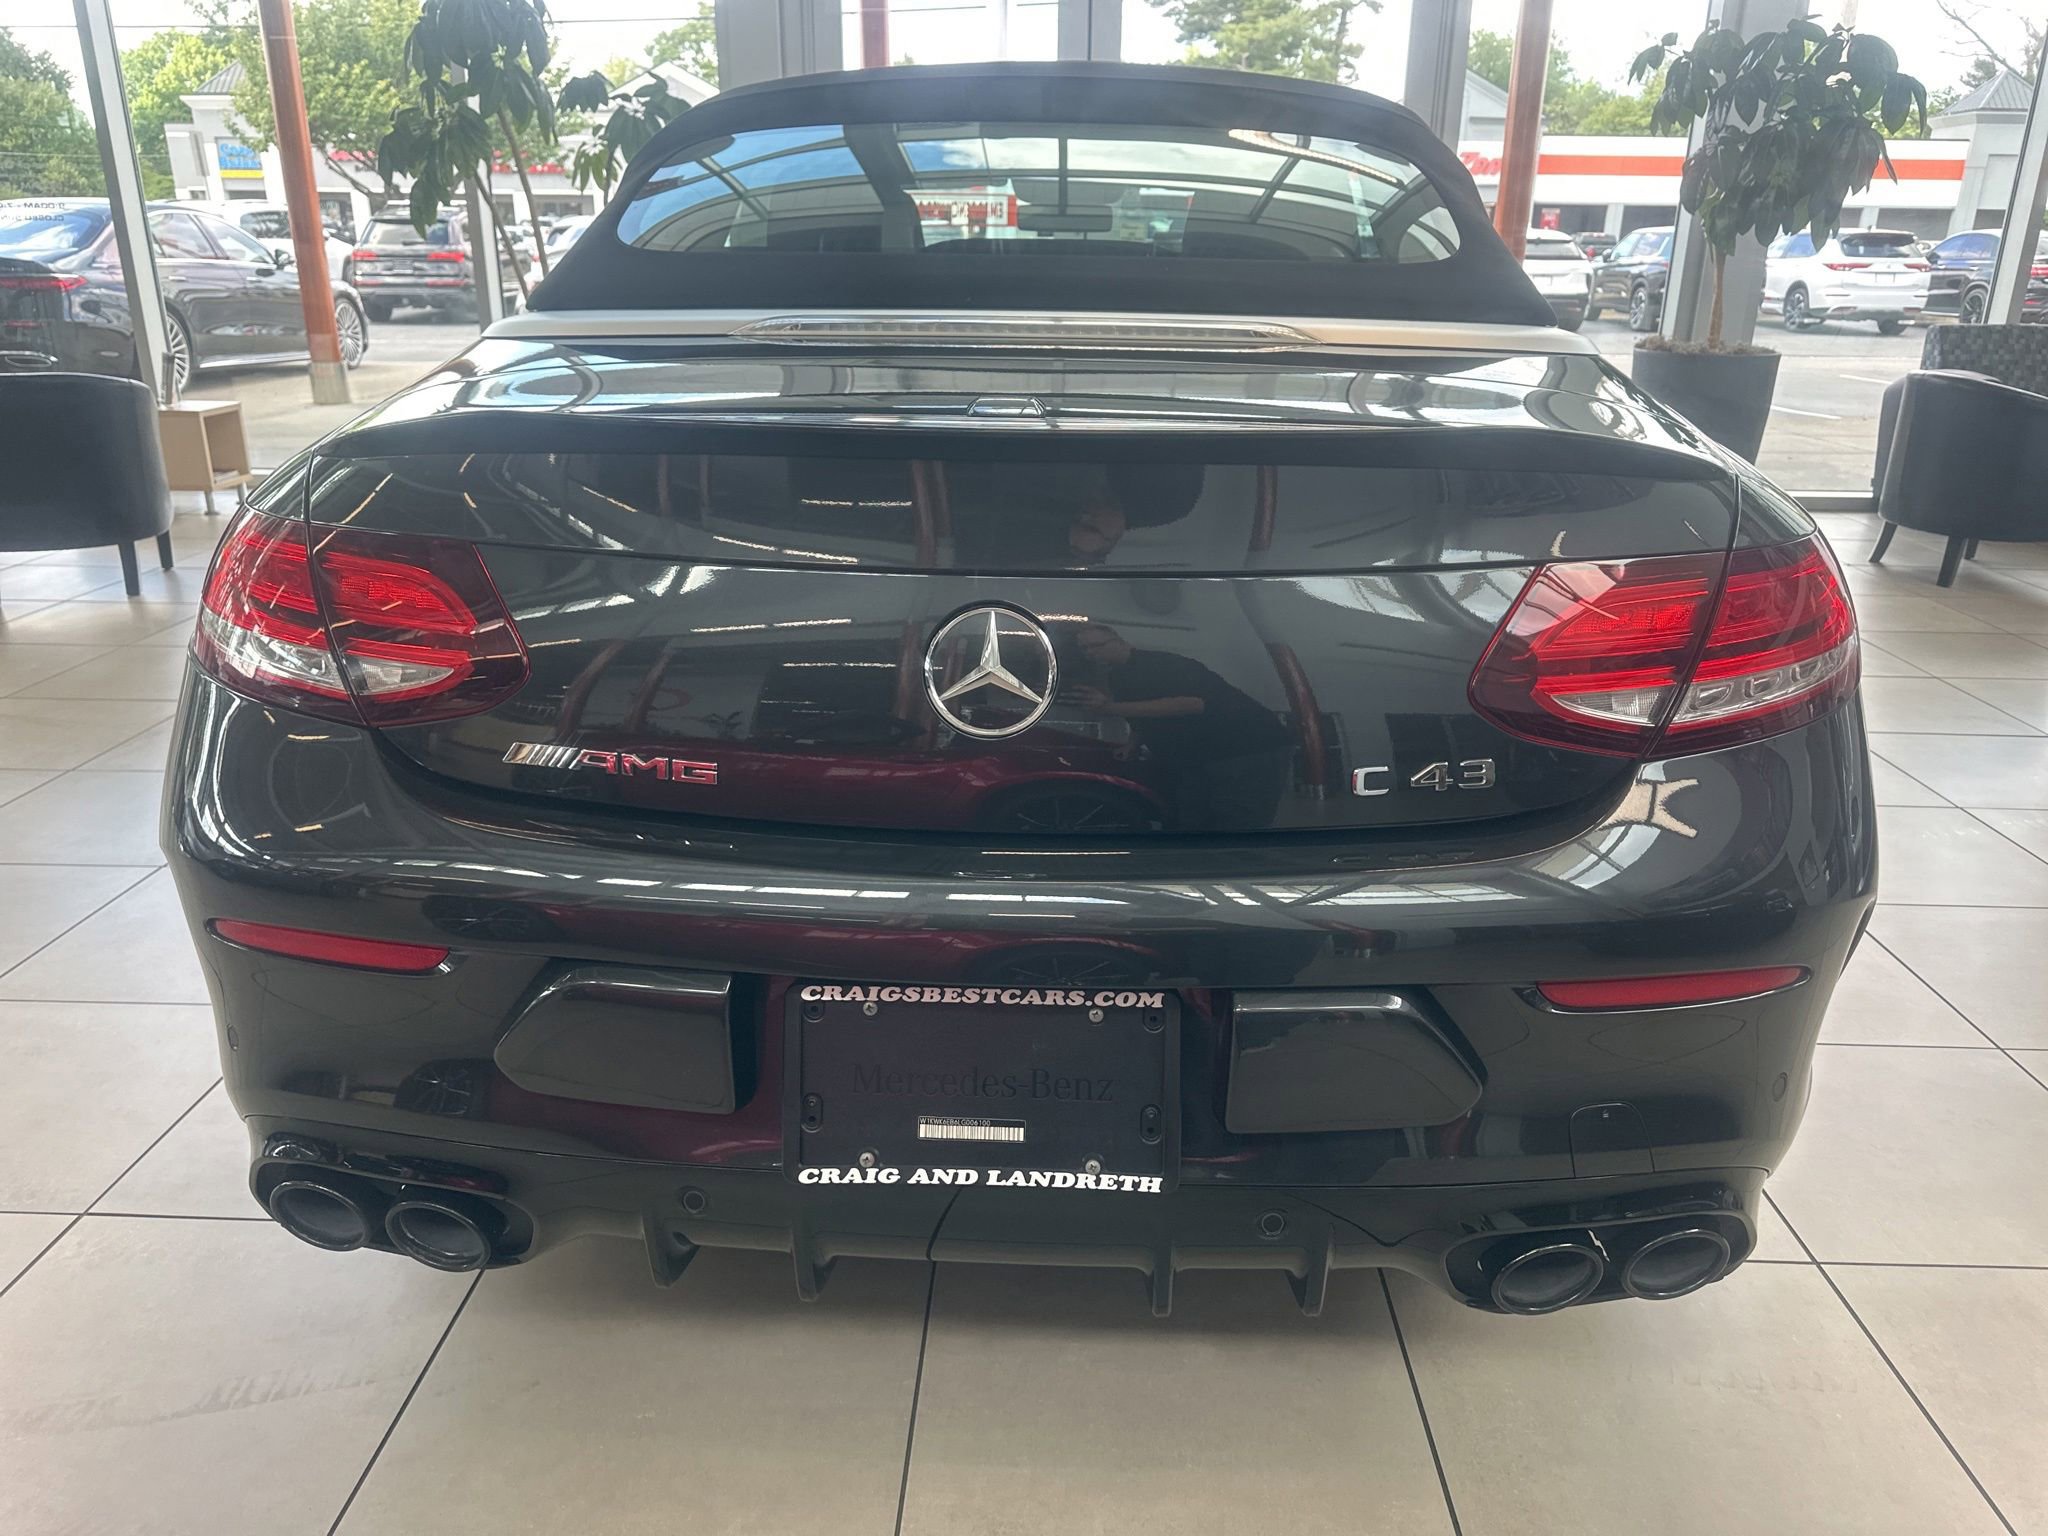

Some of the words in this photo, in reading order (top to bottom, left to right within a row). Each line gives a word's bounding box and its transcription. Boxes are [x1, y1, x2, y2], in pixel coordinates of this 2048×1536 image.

[569, 749, 718, 785] AMG
[1352, 766, 1390, 796] C
[1410, 758, 1496, 792] 43
[800, 984, 1165, 1009] CRAIGSBESTCARS.COM
[851, 1062, 1115, 1102] Mercedes-Benz
[797, 1167, 901, 1185] CRAIG
[906, 1168, 980, 1187] AND
[986, 1169, 1163, 1194] LANDRETH
